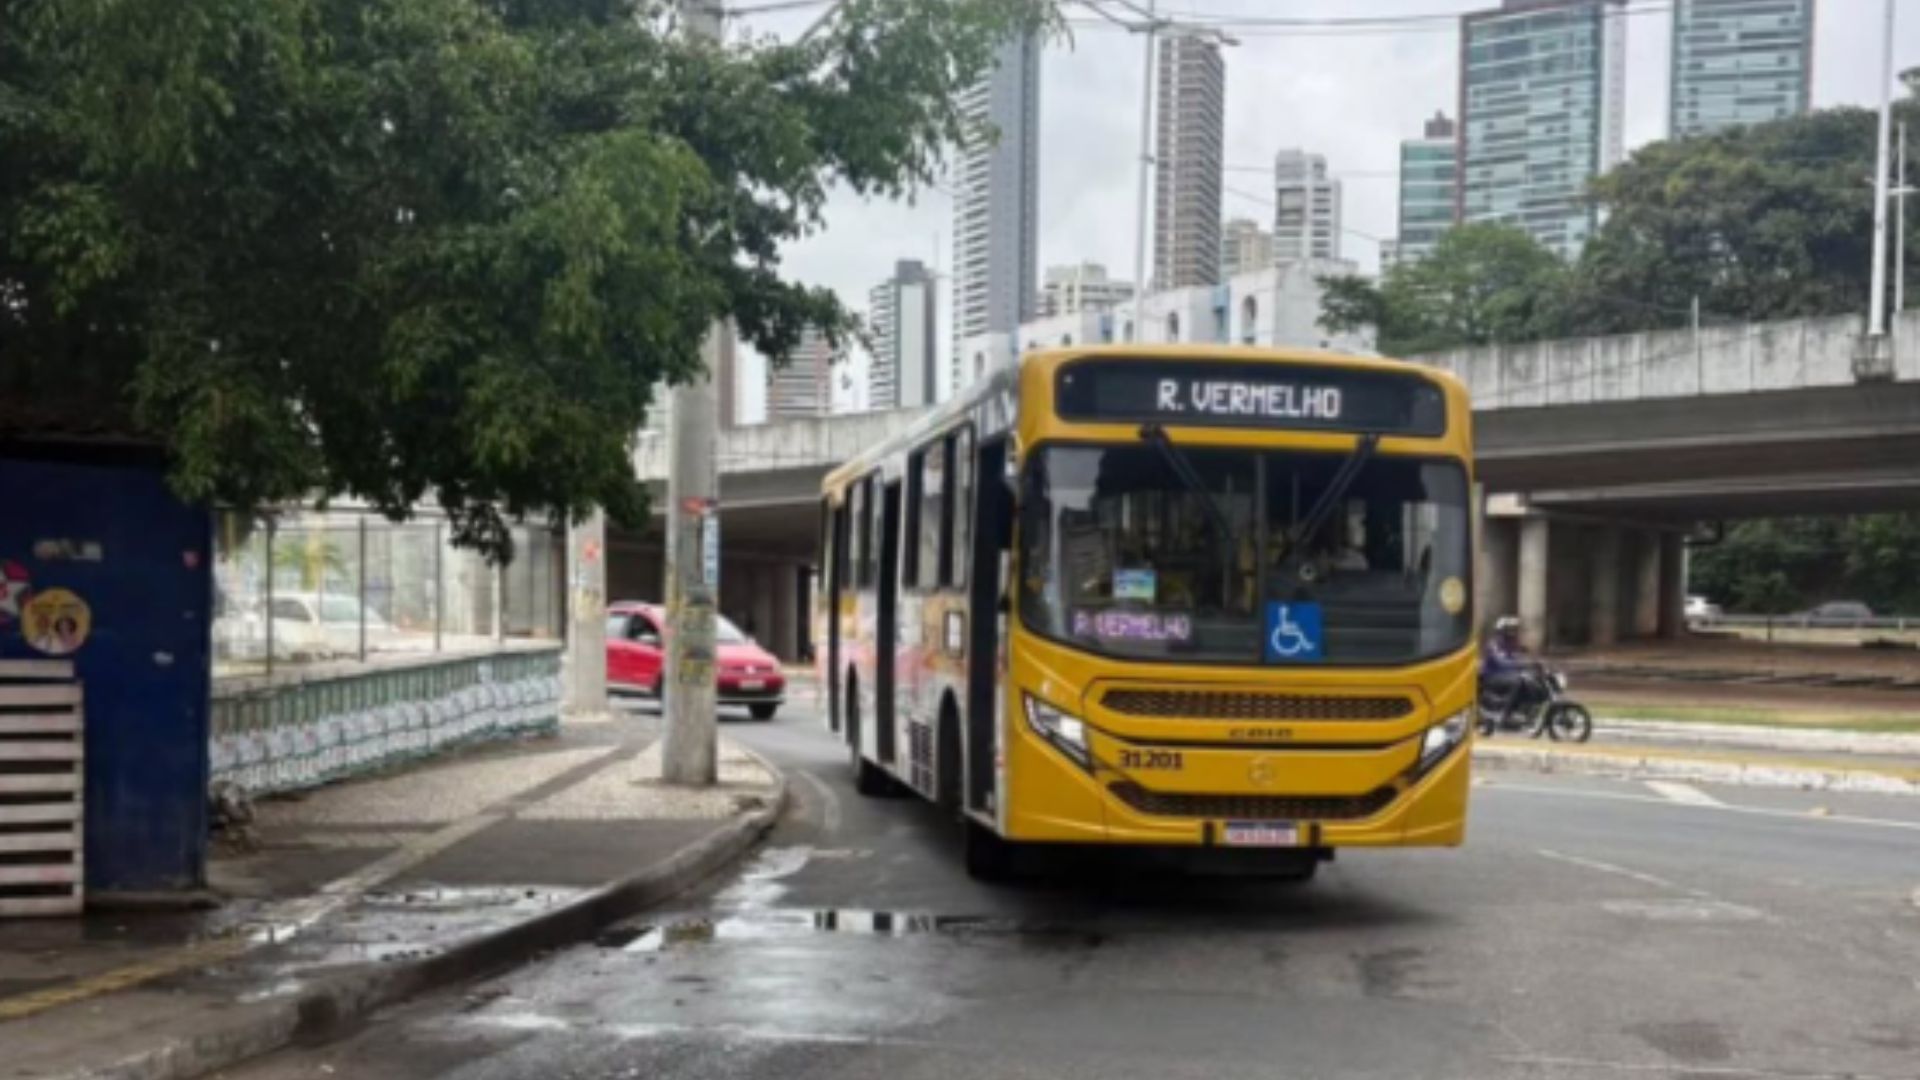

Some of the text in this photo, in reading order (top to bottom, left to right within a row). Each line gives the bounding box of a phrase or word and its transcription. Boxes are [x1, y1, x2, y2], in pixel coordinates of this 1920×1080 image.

[1157, 378, 1342, 418] R. VERMELHO
[1119, 750, 1184, 769] 31201
